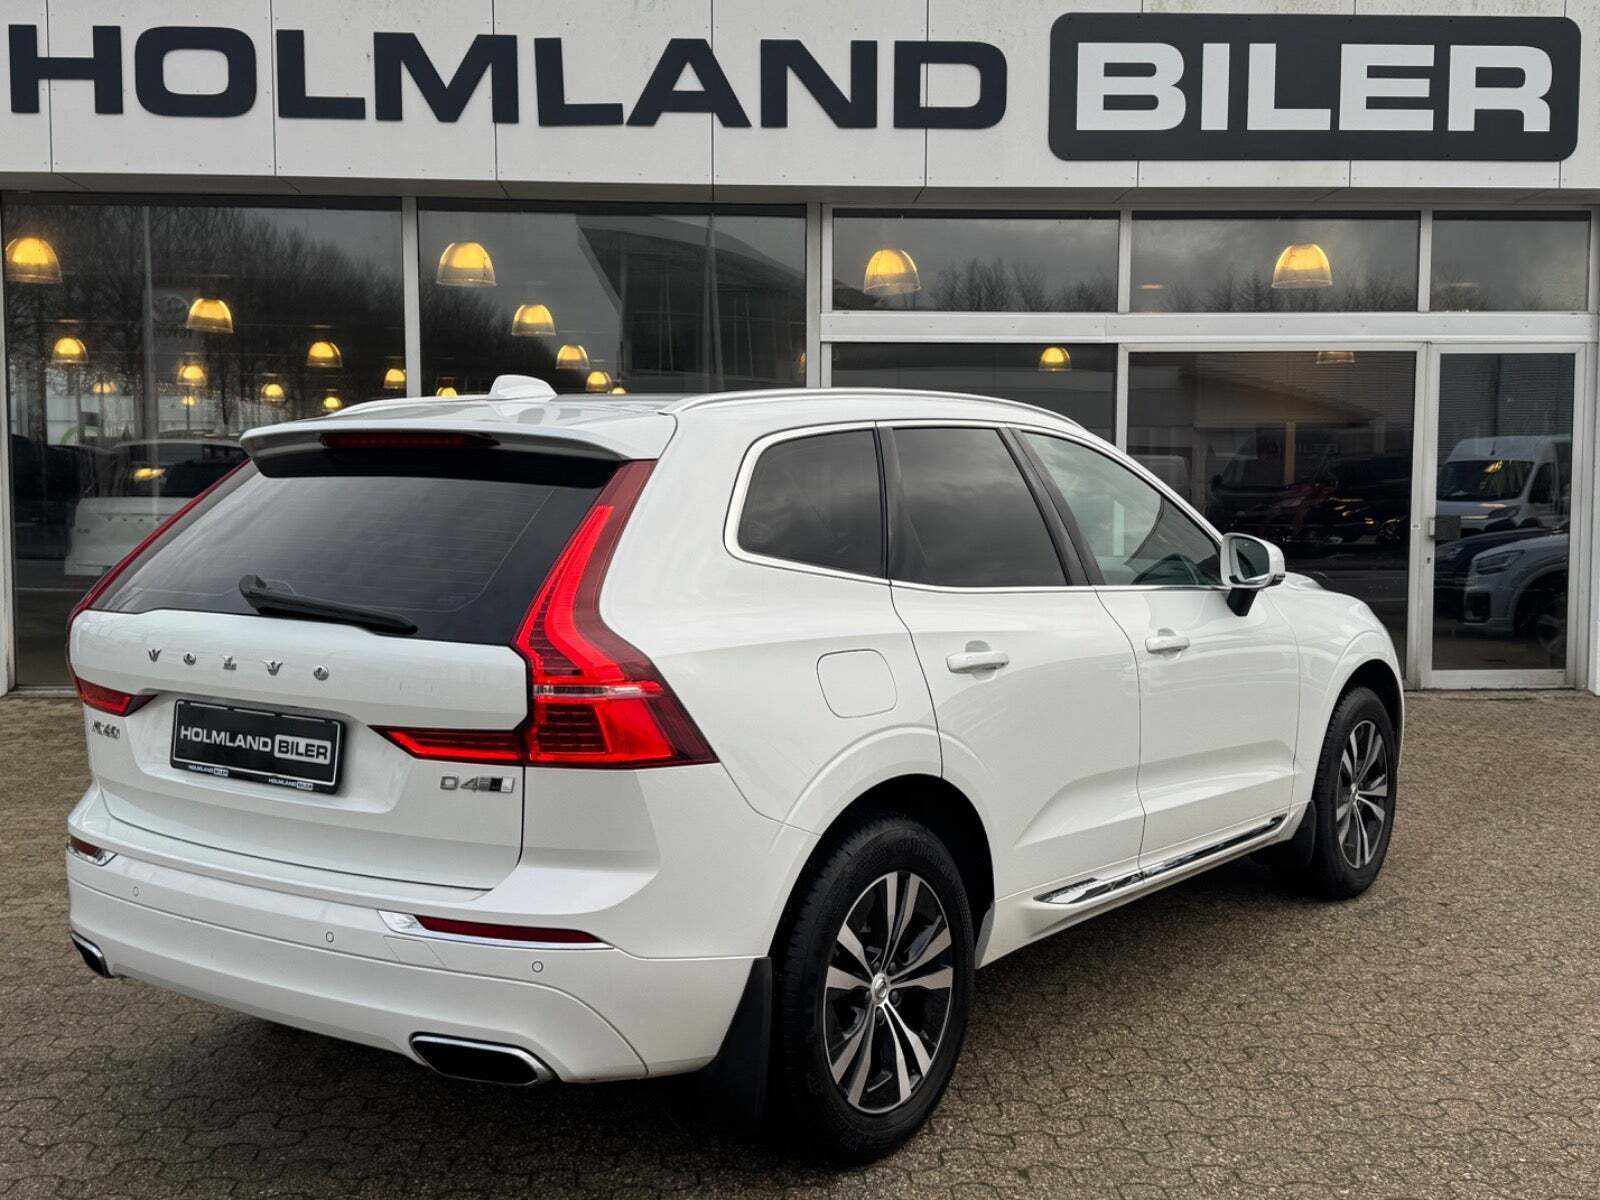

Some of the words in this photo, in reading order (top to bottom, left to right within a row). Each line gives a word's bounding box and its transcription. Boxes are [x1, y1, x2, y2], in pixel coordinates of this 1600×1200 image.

[8, 24, 1008, 130] HOLMLAND
[1075, 41, 1554, 133] BILER
[148, 648, 330, 681] VOLVO
[180, 725, 272, 752] HOLMLAND
[278, 740, 328, 761] BILER
[440, 775, 479, 792] D4
